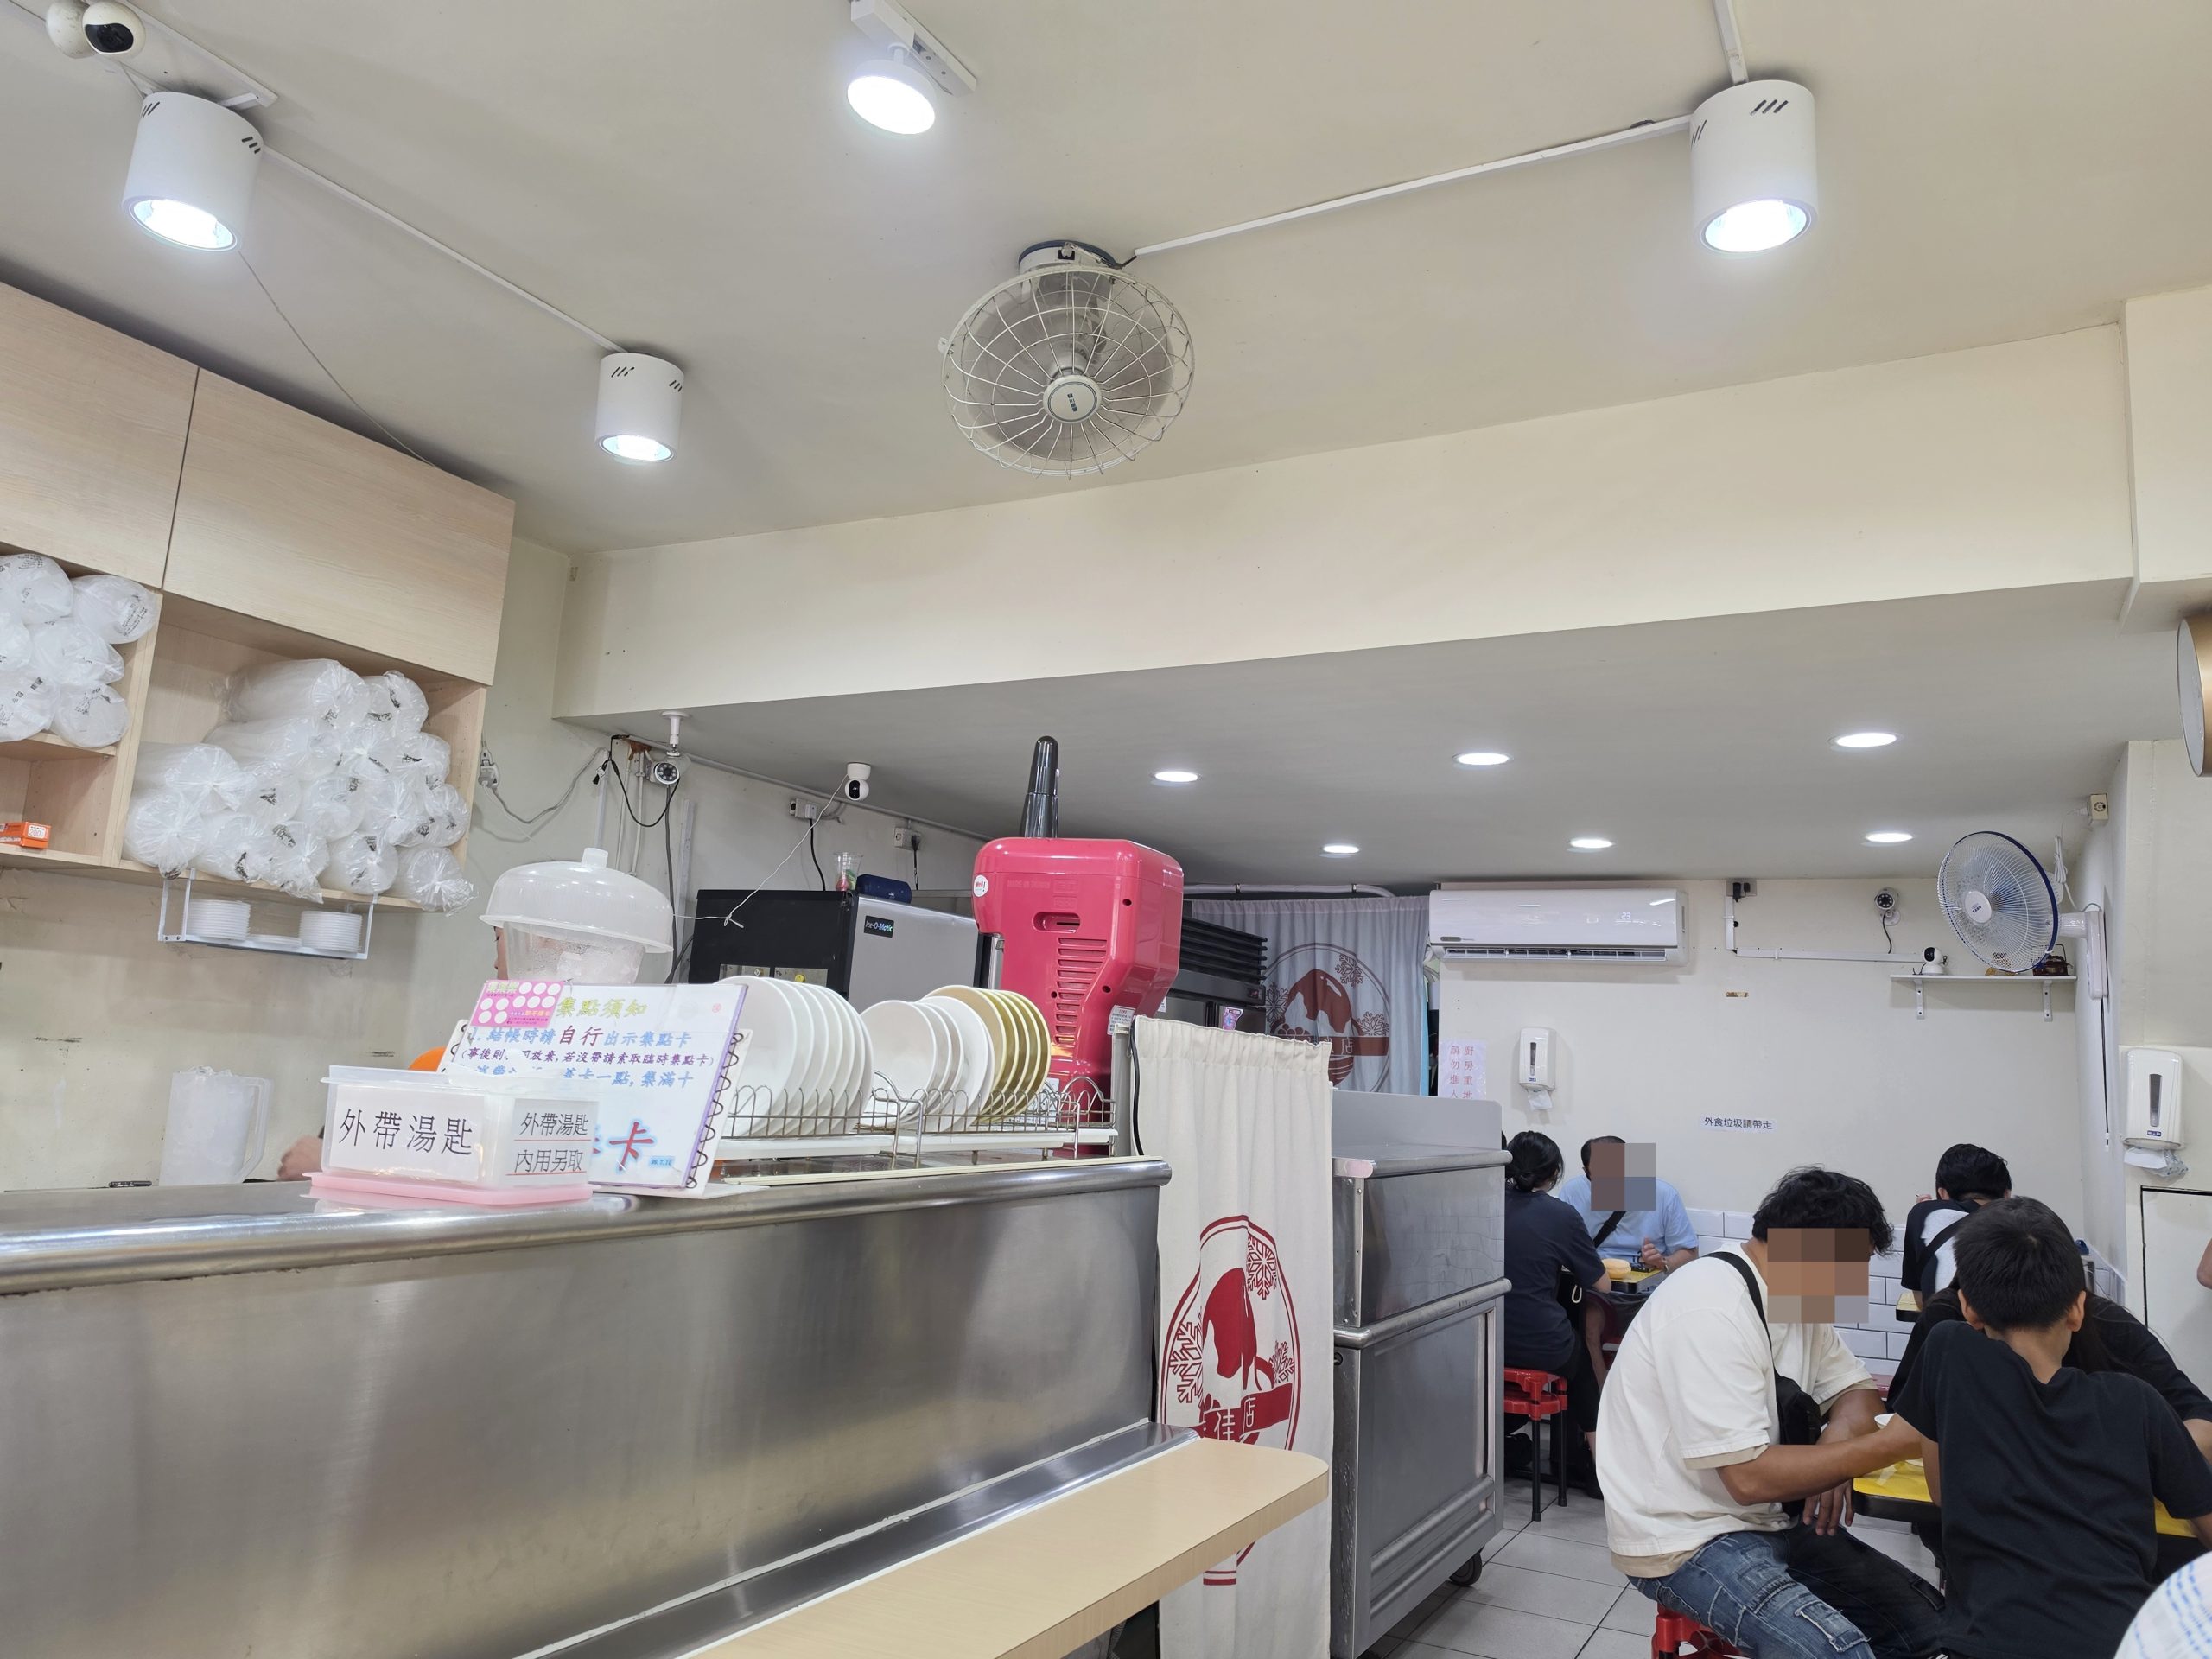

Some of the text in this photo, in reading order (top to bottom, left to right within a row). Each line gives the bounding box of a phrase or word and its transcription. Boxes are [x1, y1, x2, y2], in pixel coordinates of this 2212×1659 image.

[865, 920, 893, 932] Ice-O-Matic
[1621, 912, 1631, 920] 23
[554, 996, 648, 1019] 集點須知
[1462, 1046, 1473, 1100] 廚房重地
[339, 1108, 474, 1156] 外帶湯匙
[519, 1112, 588, 1137] 外帶湯匙
[1704, 1116, 1773, 1130] 外食垃圾請帶走
[514, 1149, 584, 1173] 內用另取
